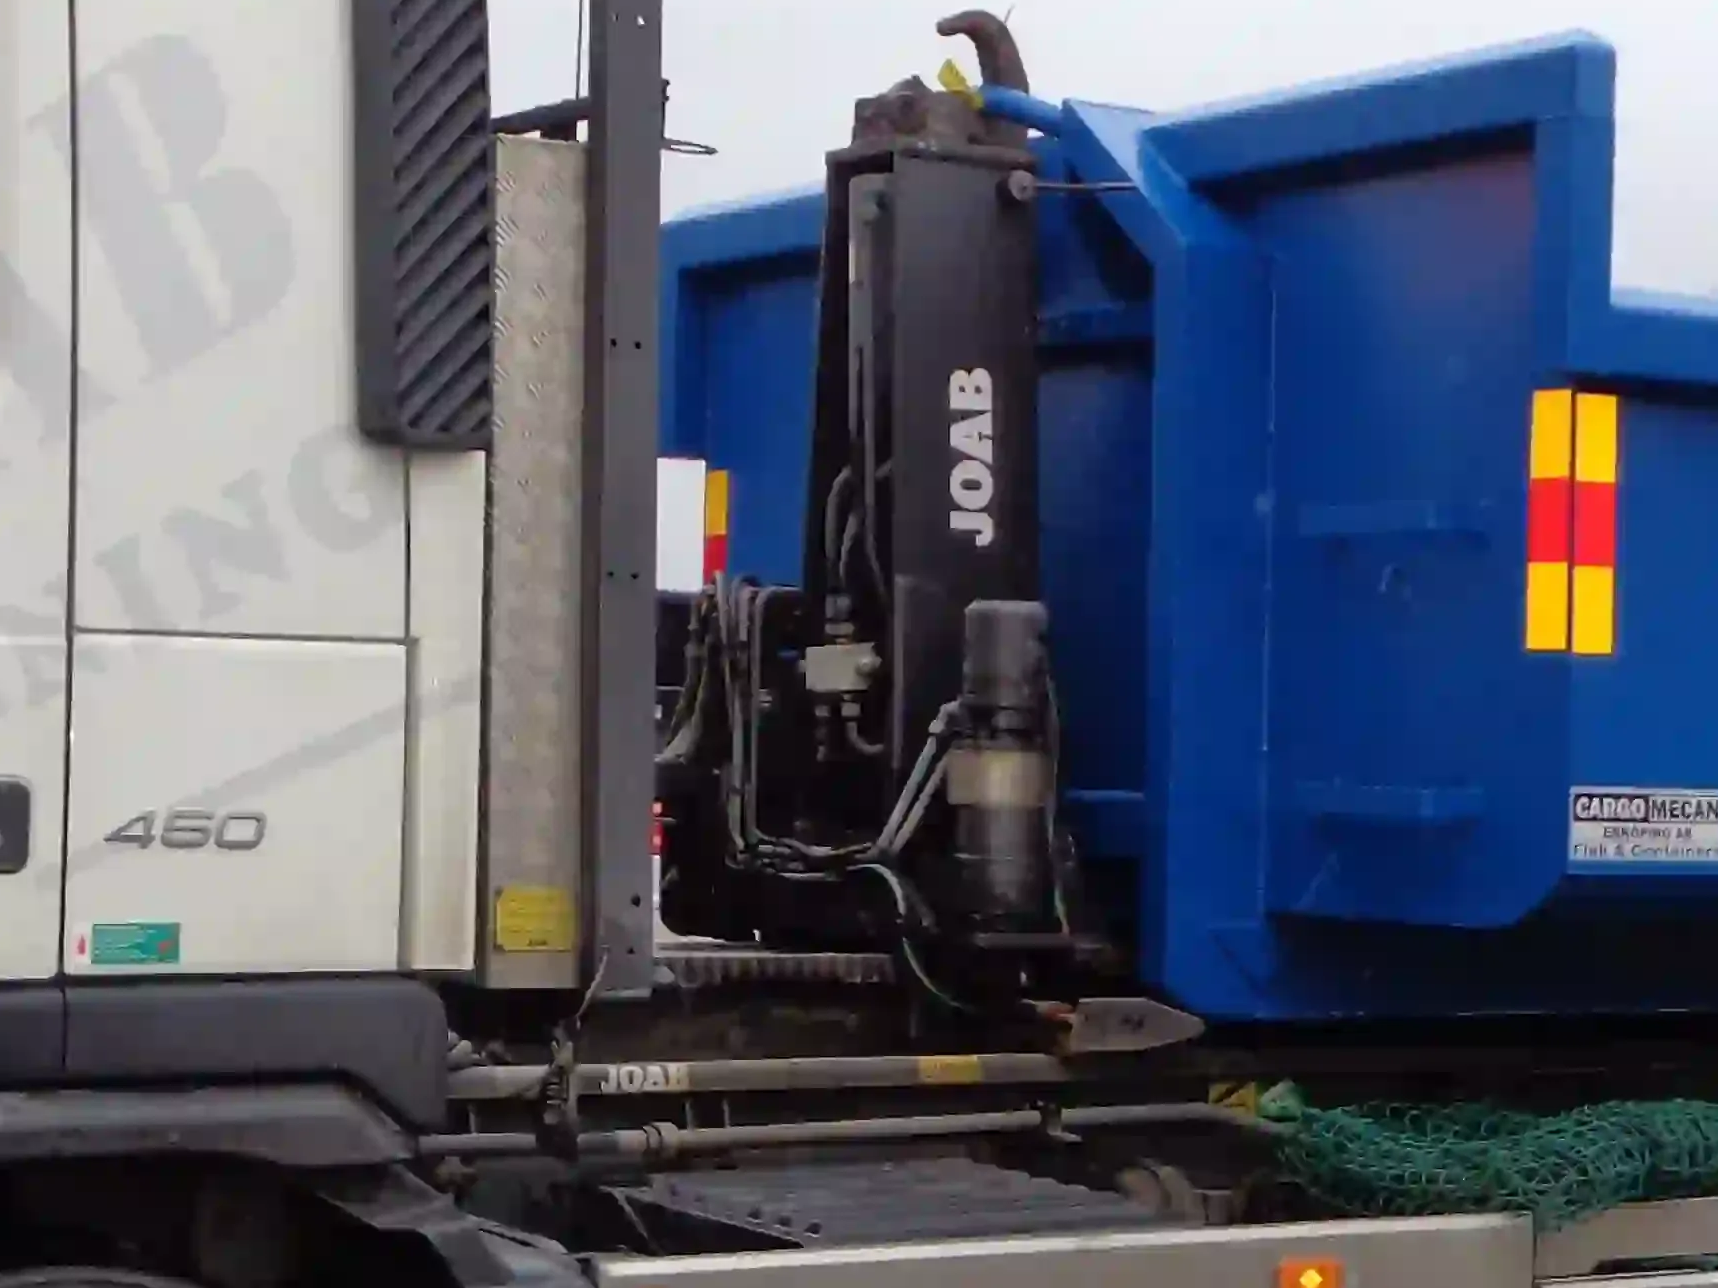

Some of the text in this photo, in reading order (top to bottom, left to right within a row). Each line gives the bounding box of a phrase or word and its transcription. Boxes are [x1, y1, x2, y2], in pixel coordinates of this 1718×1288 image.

[949, 368, 993, 547] JOAB
[103, 809, 268, 851] 460
[599, 1062, 690, 1095] JOAB
